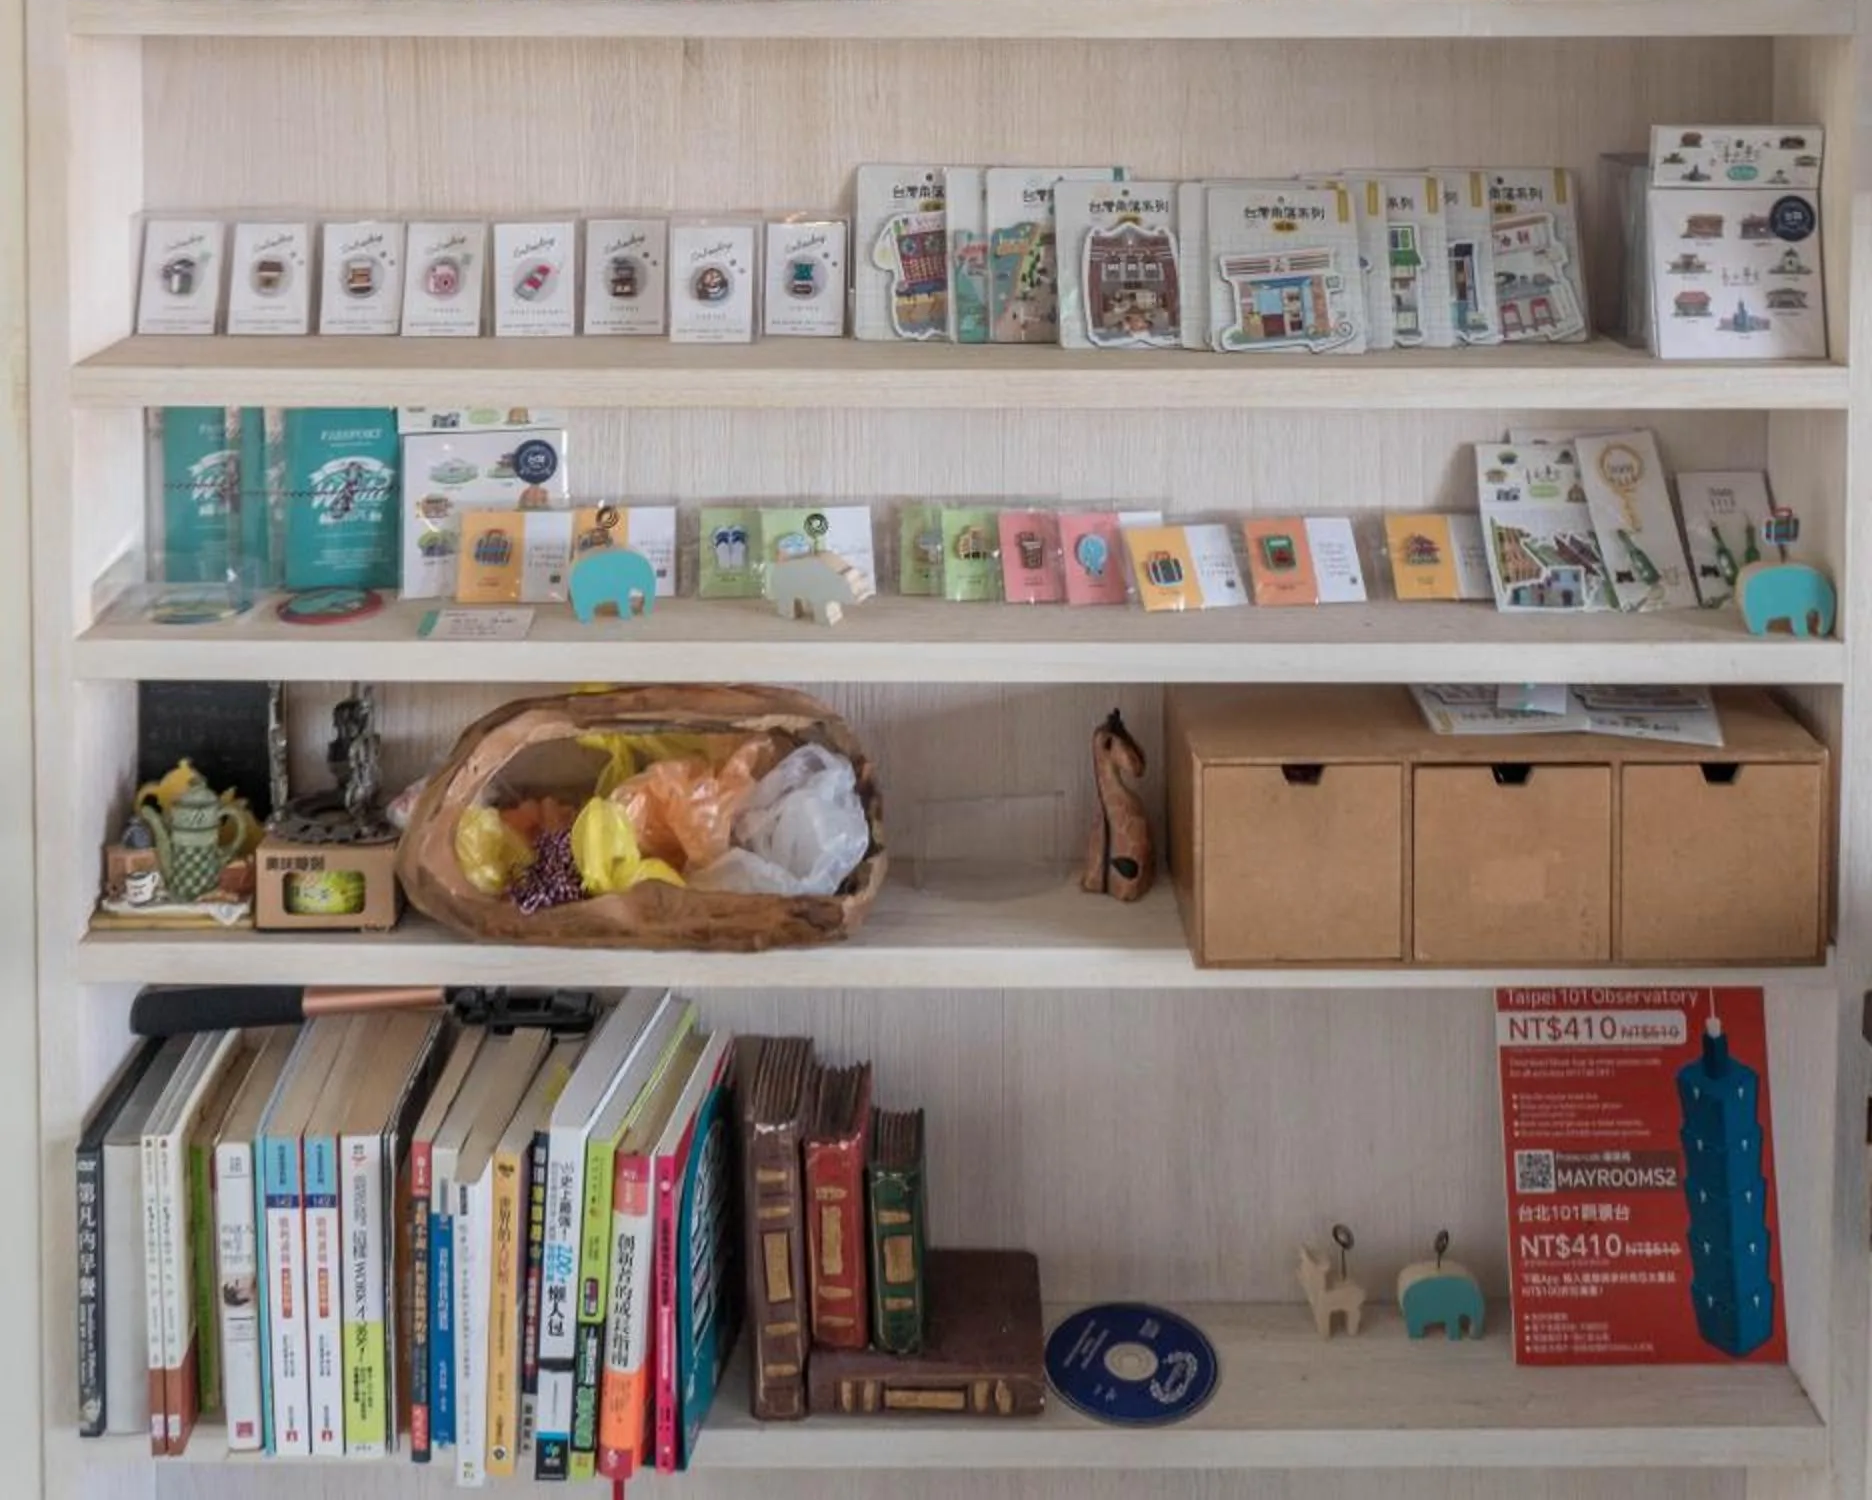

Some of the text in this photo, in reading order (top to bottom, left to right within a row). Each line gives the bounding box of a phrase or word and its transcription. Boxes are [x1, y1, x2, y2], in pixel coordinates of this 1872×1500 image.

[1507, 988, 1698, 1008] Taipei 101 Observatory
[1508, 1015, 1617, 1041] NT$410
[1556, 1168, 1677, 1188] MAYROOMS2
[1520, 1233, 1622, 1259] NT$410
